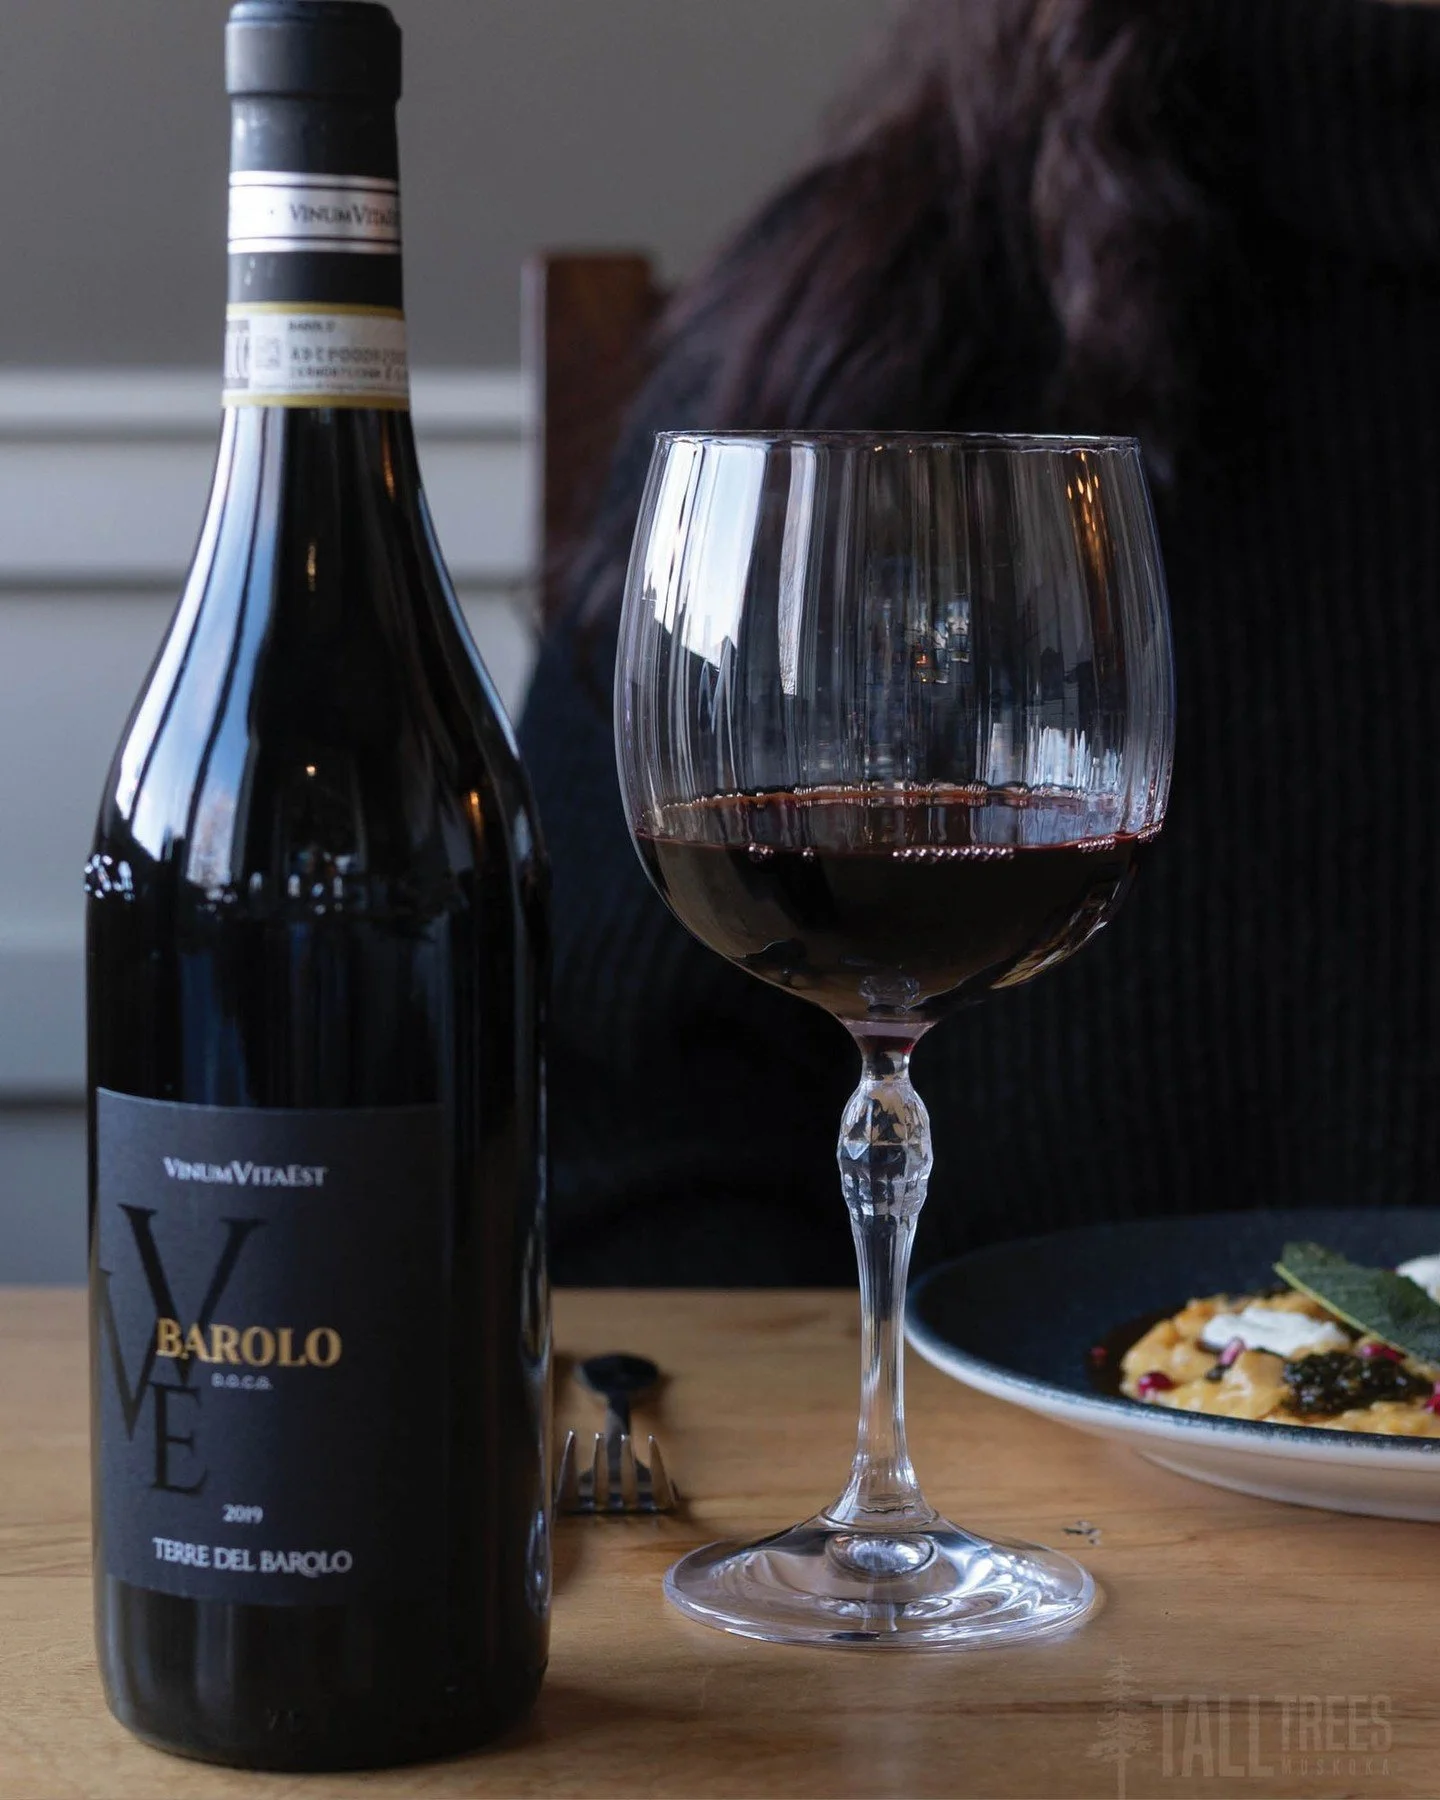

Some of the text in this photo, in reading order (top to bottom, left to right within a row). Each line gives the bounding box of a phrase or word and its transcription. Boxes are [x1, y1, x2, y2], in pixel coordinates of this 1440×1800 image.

[156, 1317, 342, 1368] BAROLO
[223, 1504, 263, 1525] 2019
[153, 1537, 352, 1578] TERRE DEL BAROLO
